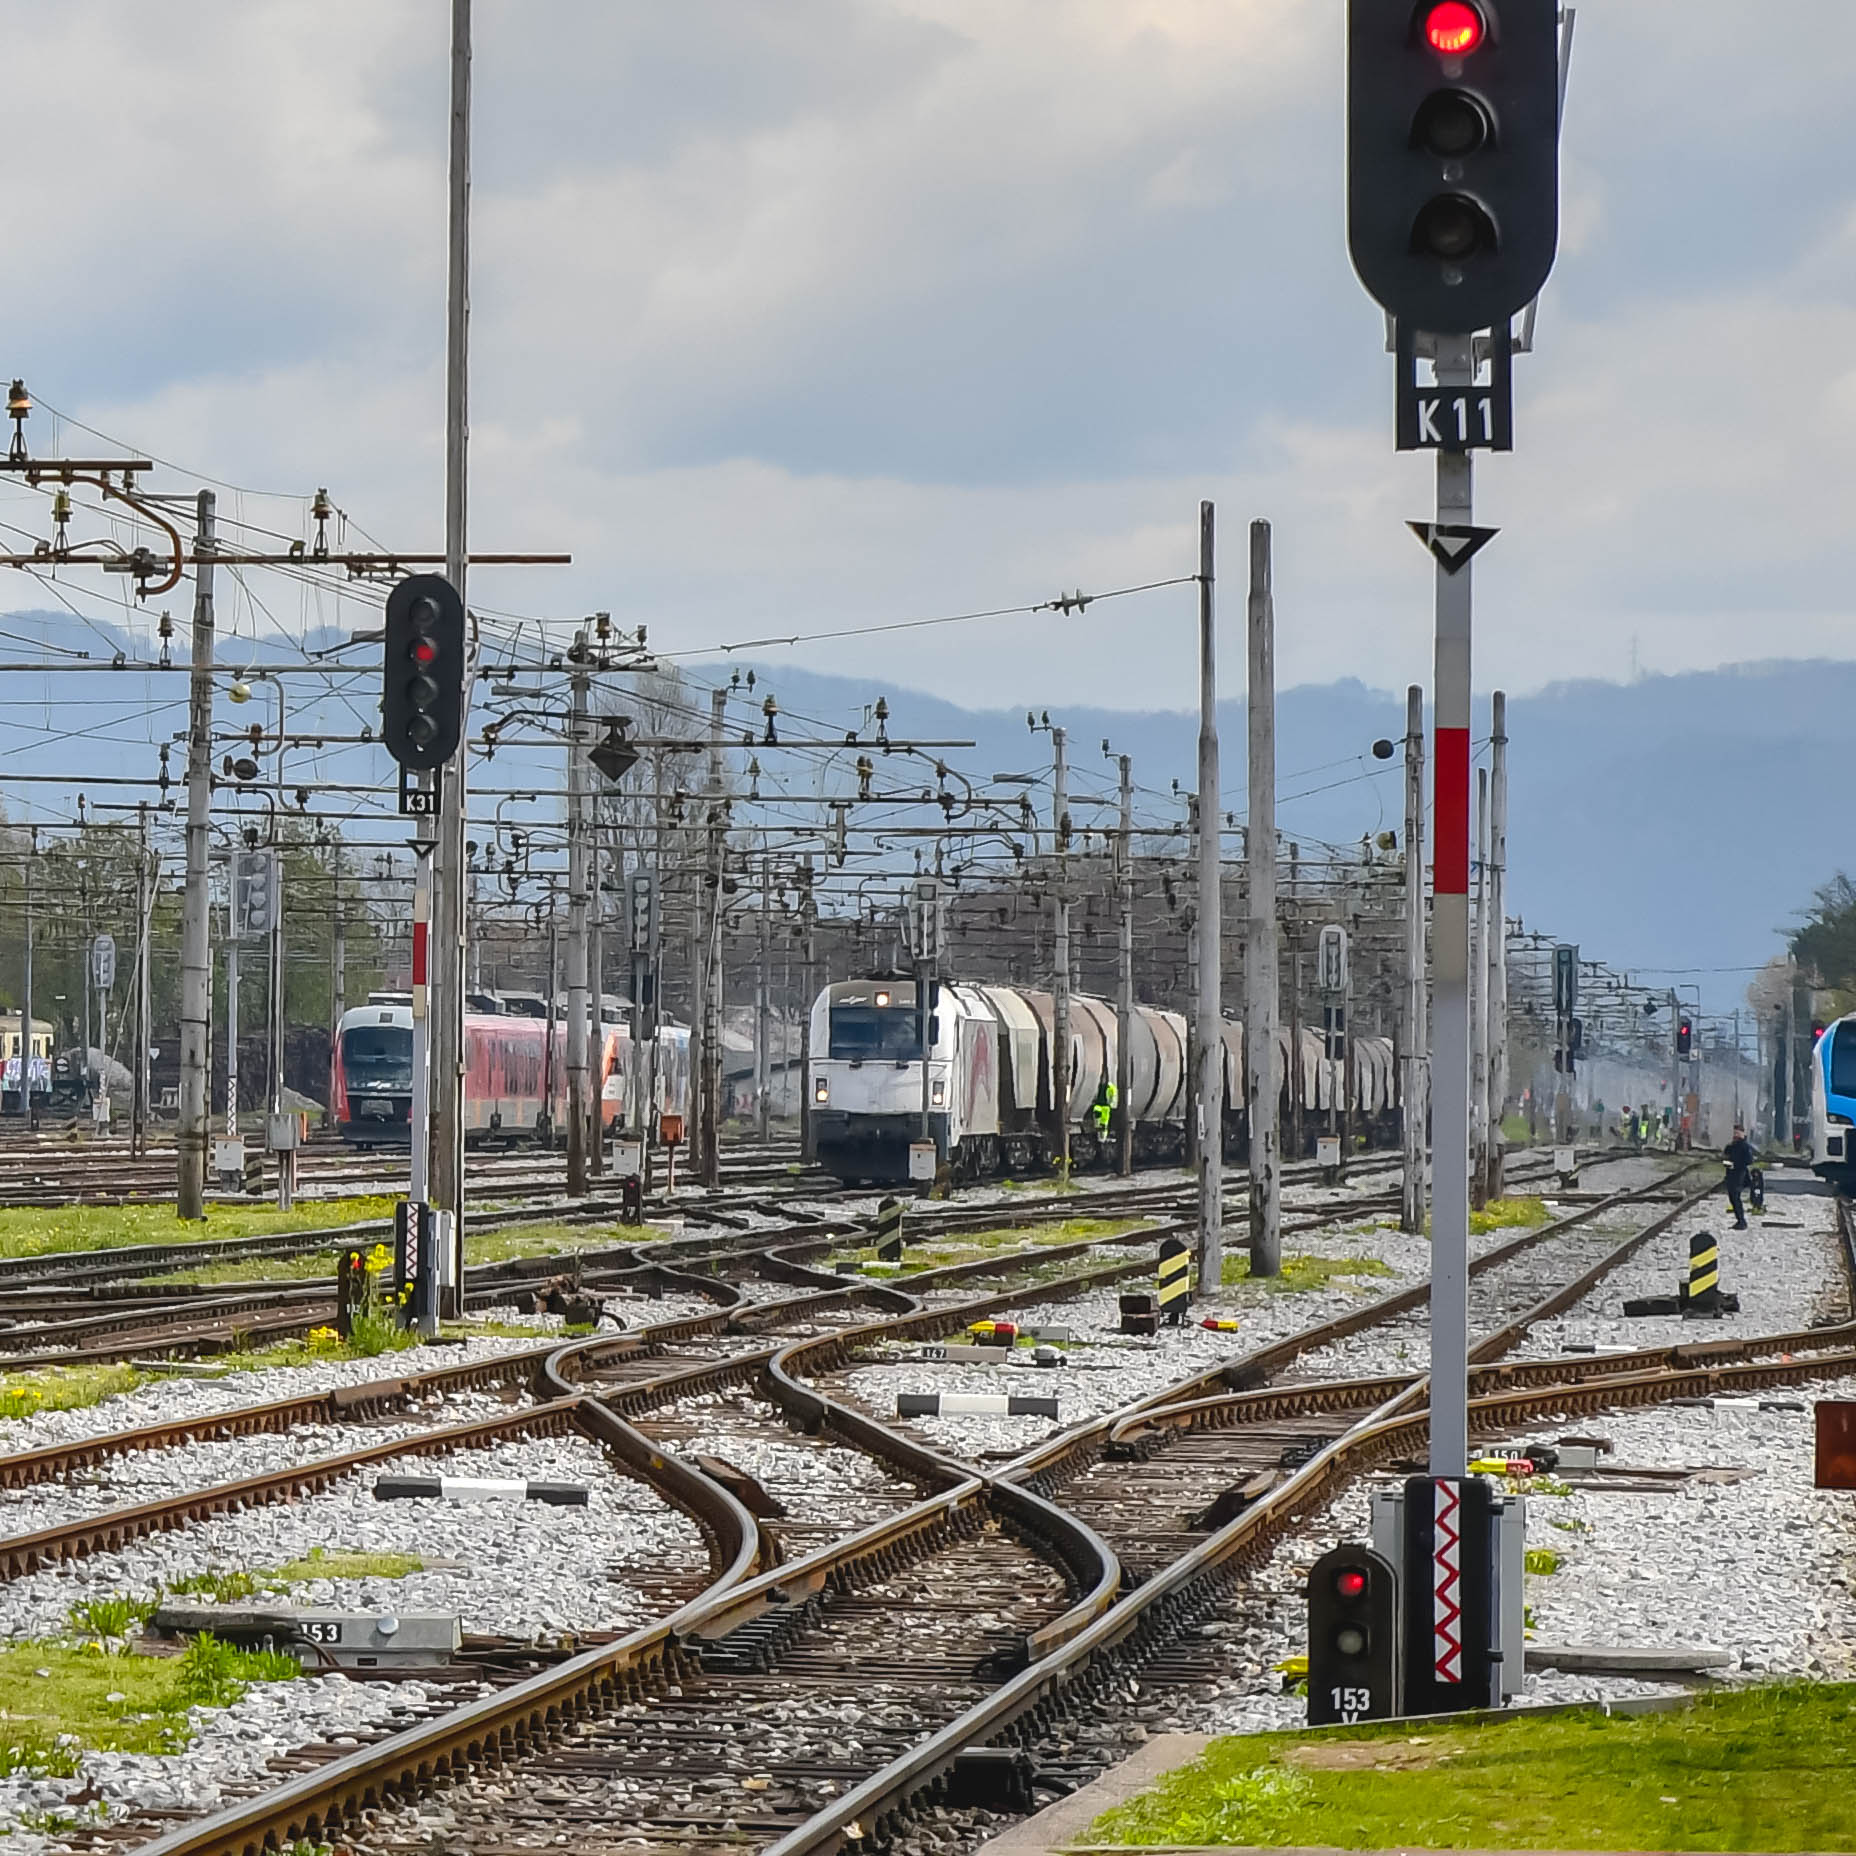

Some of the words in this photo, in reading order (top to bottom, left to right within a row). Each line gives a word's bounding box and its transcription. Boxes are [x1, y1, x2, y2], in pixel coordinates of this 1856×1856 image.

[1418, 397, 1492, 442] K11
[406, 794, 434, 812] K31
[1331, 1687, 1370, 1711] 153
